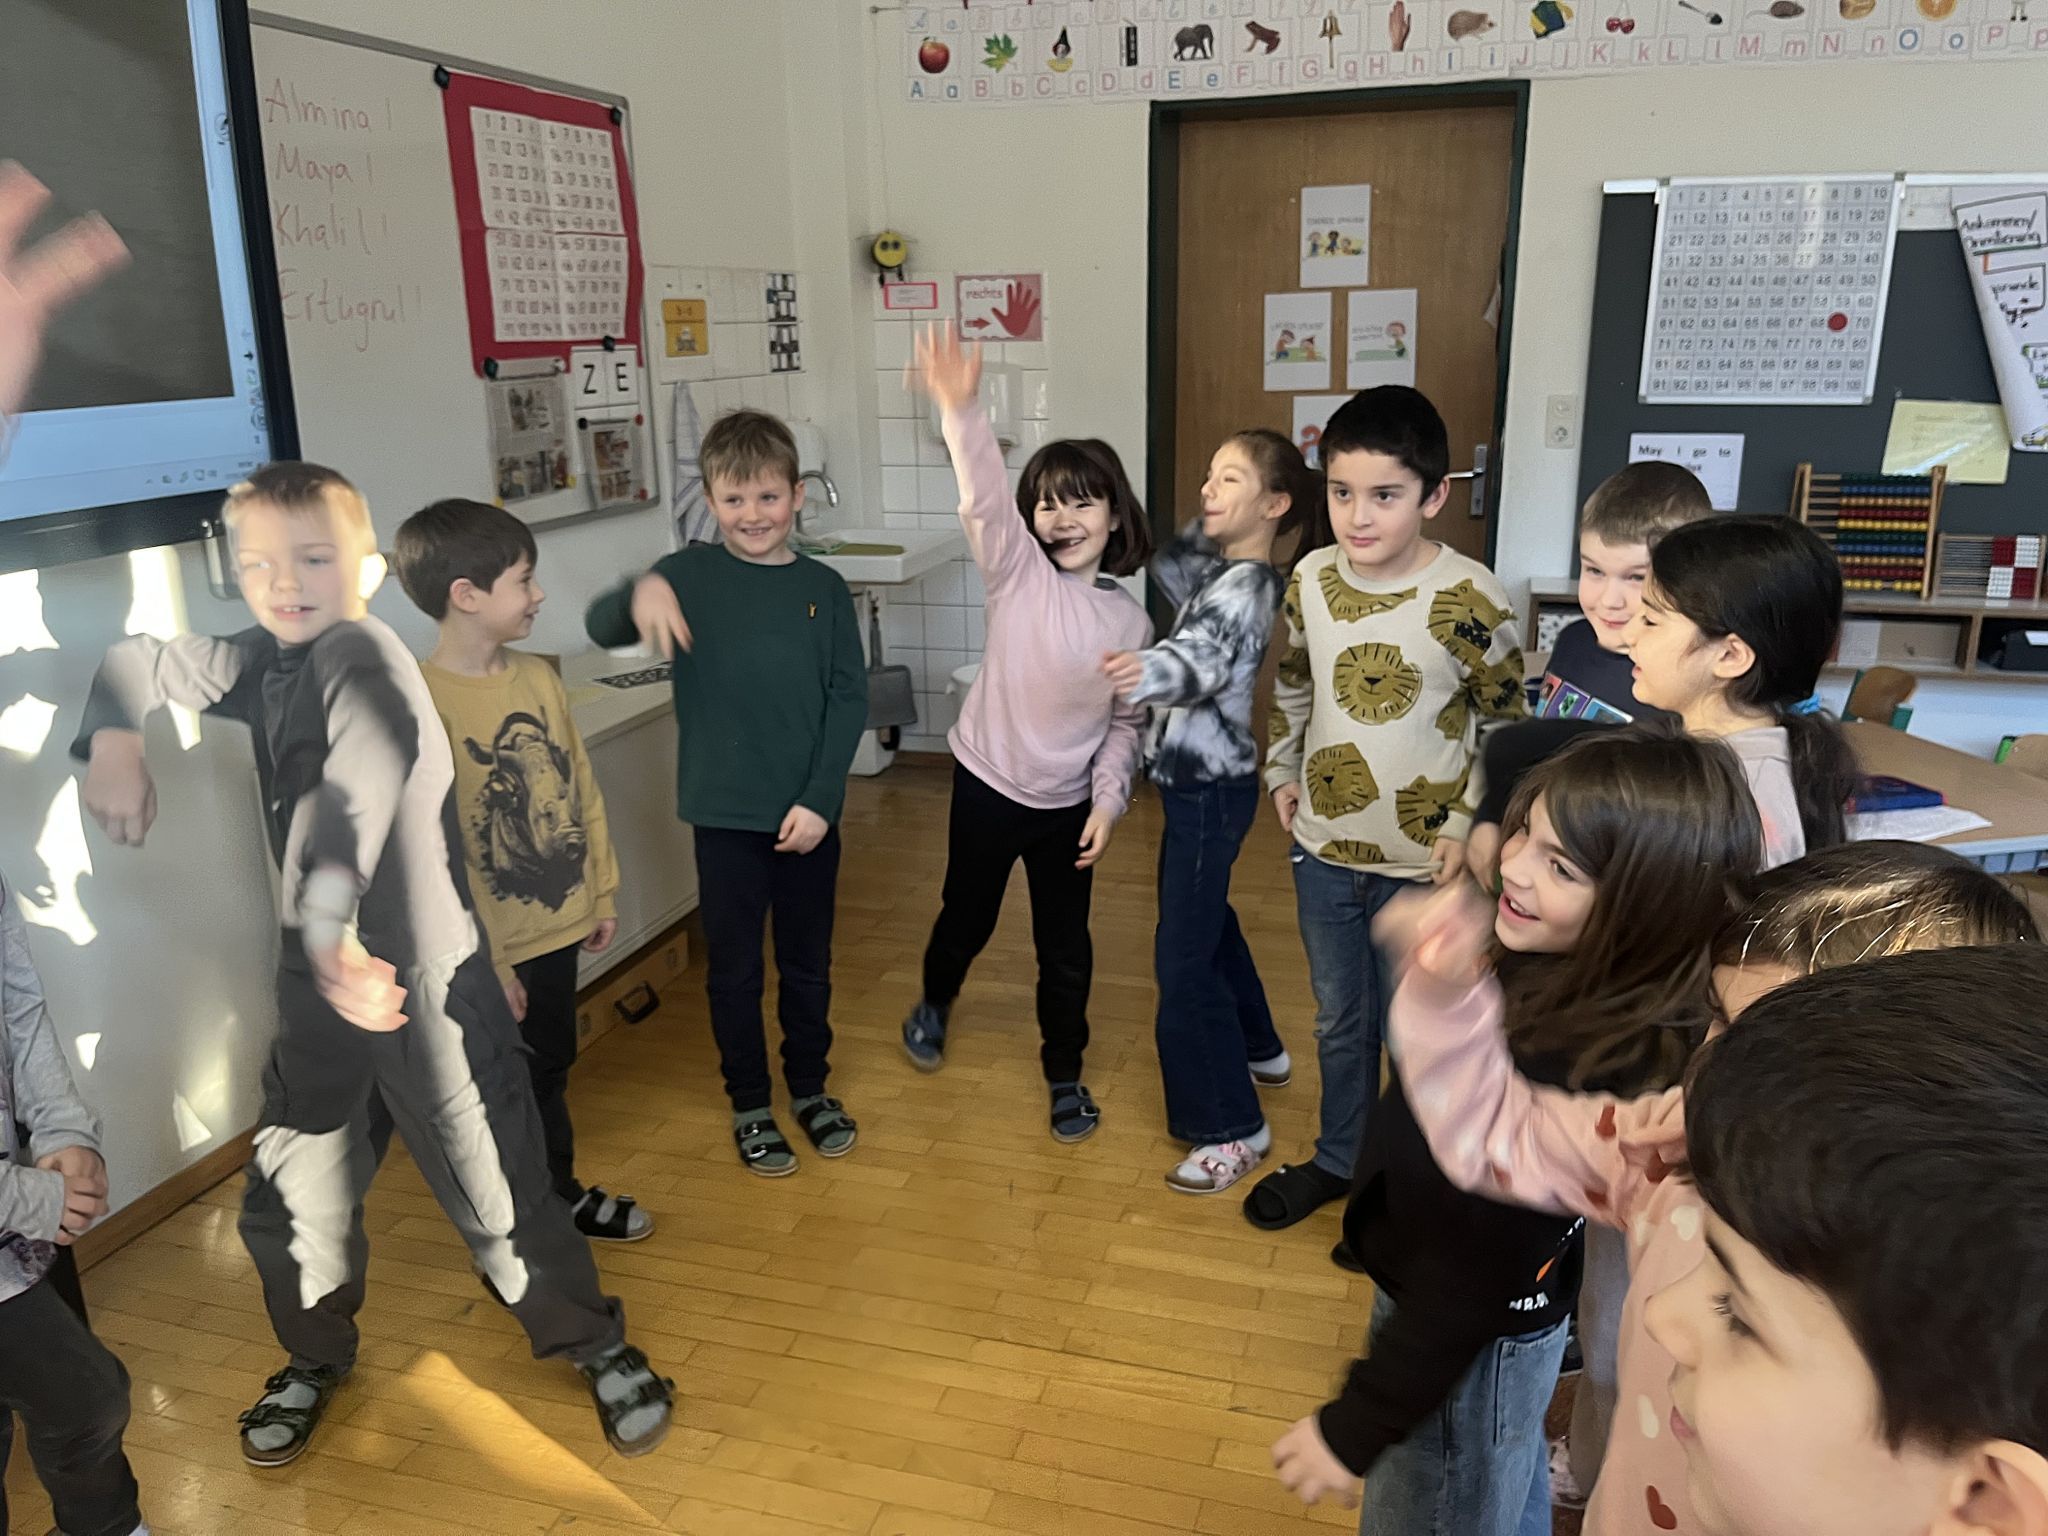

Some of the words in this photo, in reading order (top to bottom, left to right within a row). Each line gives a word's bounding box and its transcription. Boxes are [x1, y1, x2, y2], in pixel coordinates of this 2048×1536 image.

[911, 81, 923, 97] A
[946, 85, 958, 98] a
[975, 80, 988, 97] B
[1011, 80, 1023, 96] b
[1036, 76, 1050, 95] C
[1076, 80, 1086, 92] c
[1102, 73, 1116, 90] D
[1140, 72, 1152, 88] d
[1168, 70, 1180, 89] E
[1206, 72, 1218, 86] e
[1236, 66, 1248, 83] F
[1302, 60, 1318, 78] G
[1344, 60, 1357, 81] g
[1370, 56, 1384, 75] H
[1412, 54, 1424, 72] h
[1592, 43, 1607, 62] K
[1638, 42, 1649, 60] k
[1668, 41, 1679, 60] L
[1740, 35, 1760, 54] M
[1785, 39, 1806, 54] m
[1824, 34, 1840, 52] N
[1872, 36, 1884, 50] n
[1900, 29, 1918, 50] O
[1950, 33, 1964, 49] o
[1988, 26, 2003, 44] P
[265, 78, 371, 133] Almina
[276, 143, 353, 193] Maya
[583, 364, 597, 394] Z
[616, 363, 629, 391] E
[1638, 446, 1662, 456] May
